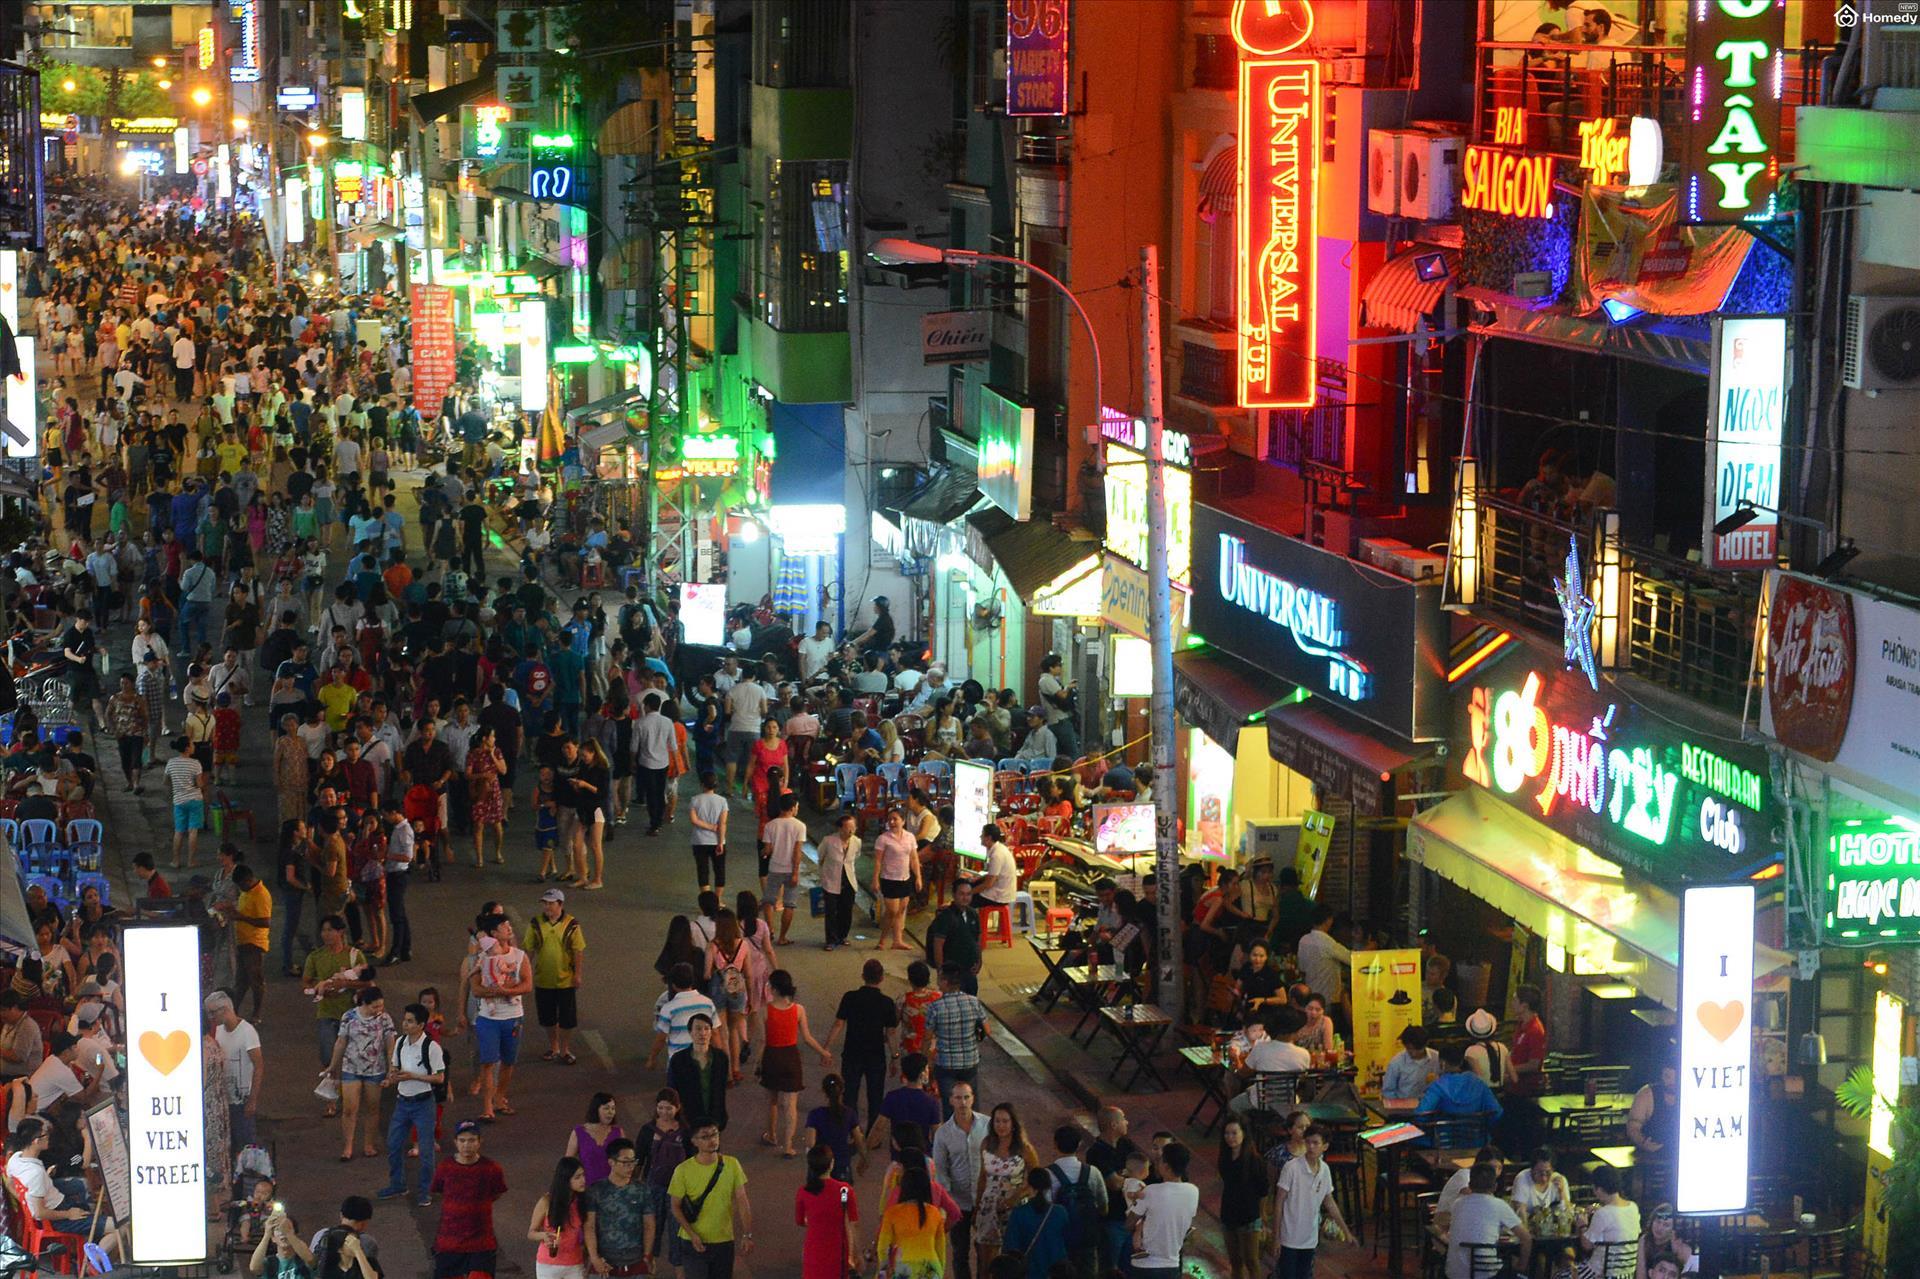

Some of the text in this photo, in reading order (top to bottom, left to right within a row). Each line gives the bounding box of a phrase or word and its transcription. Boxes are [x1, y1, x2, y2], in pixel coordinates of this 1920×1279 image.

[1017, 81, 1055, 108] STORE
[1494, 106, 1523, 145] BIA
[1706, 40, 1769, 210] TÂY
[1578, 116, 1630, 187] Tiger
[1264, 69, 1310, 335] UNIVERSAL
[1247, 323, 1266, 384] PUB
[1718, 530, 1773, 561] HOTEL
[1219, 532, 1343, 649] UNIVERSAL
[1328, 659, 1366, 702] PUB
[1700, 796, 1744, 855] Club
[1719, 955, 1728, 977] I
[160, 992, 168, 1012] I
[1692, 1065, 1745, 1089] VIET
[151, 1096, 182, 1116] BUI
[146, 1130, 188, 1150] VIEN
[1693, 1114, 1743, 1139] NAM
[136, 1163, 200, 1185] STREET
